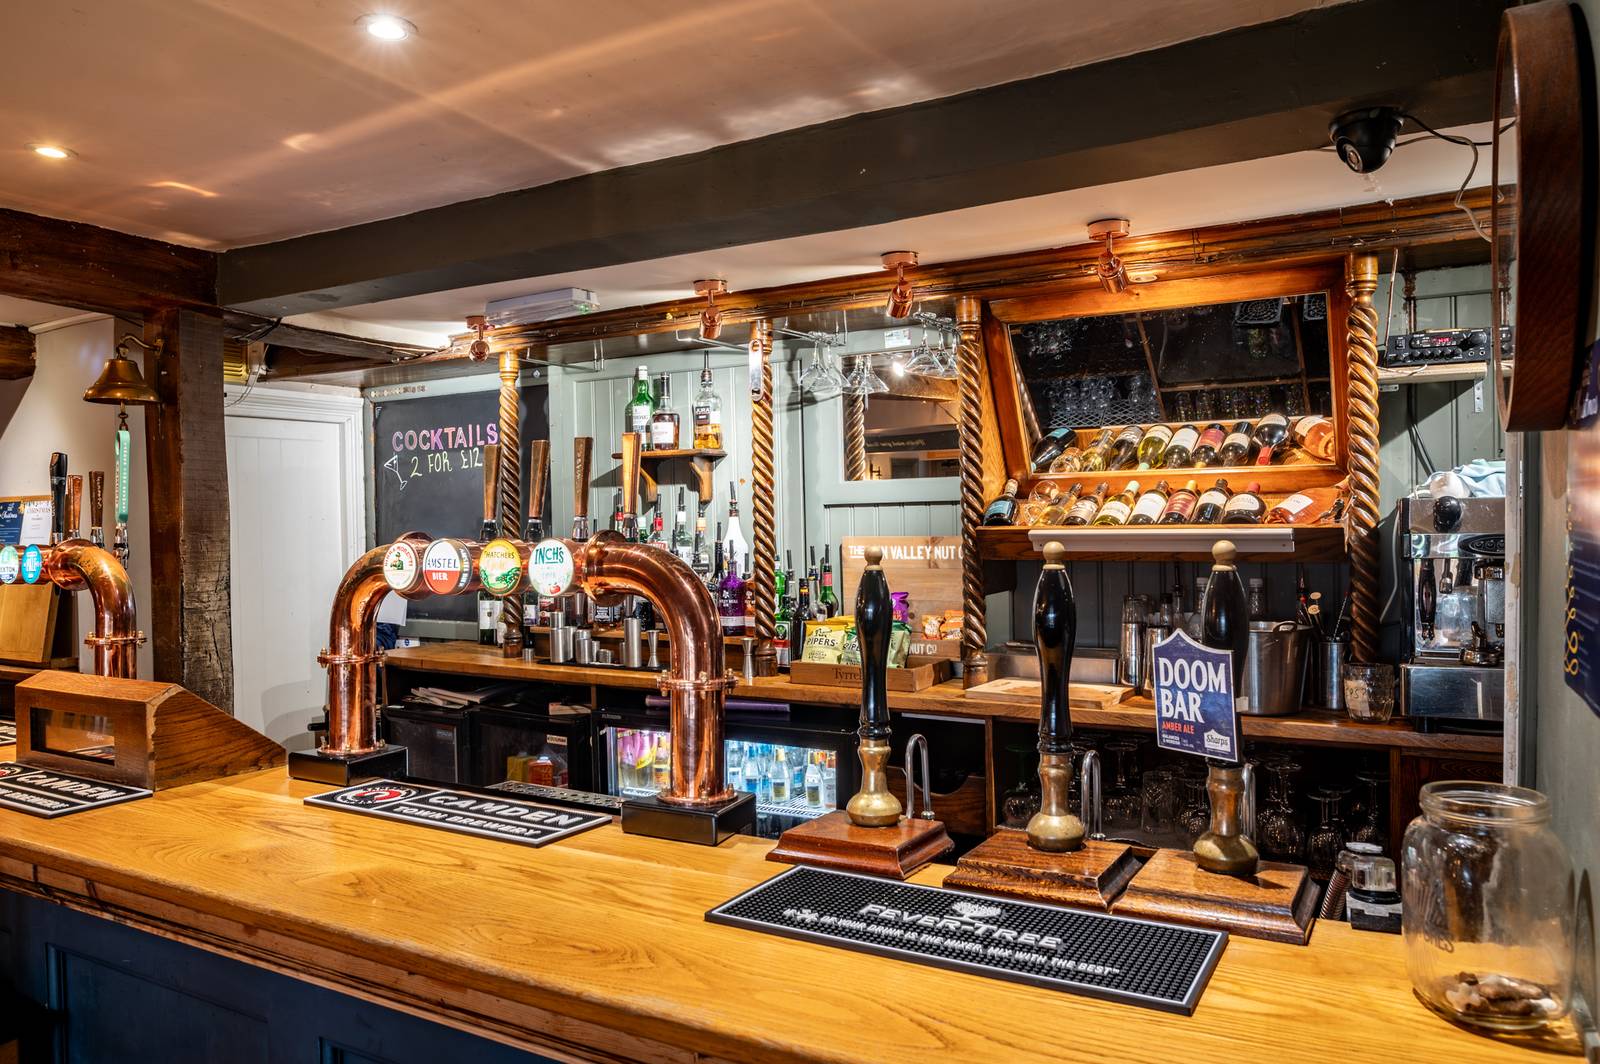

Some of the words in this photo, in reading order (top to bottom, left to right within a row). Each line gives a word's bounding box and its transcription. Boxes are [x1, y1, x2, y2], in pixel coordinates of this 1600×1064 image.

[392, 423, 499, 451] COCKTAILS
[410, 456, 423, 478] 2
[428, 451, 452, 473] FOR
[460, 447, 483, 469] £12
[426, 558, 459, 569] AMSTEL
[484, 551, 516, 560] THATCHERS
[848, 545, 865, 556] THE
[892, 545, 931, 561] VALLEY
[934, 546, 957, 561] NUT
[431, 571, 449, 581] BIER
[807, 637, 836, 647] PIPERS
[909, 643, 926, 655] NUT
[1158, 656, 1228, 695] DOOM
[1160, 688, 1206, 724] BAR
[1162, 720, 1182, 733] AMBER
[1183, 724, 1195, 735] ALE
[17, 774, 126, 800] CAMDEN
[393, 806, 449, 820] TOWN
[445, 816, 542, 837] BREWERY
[428, 795, 584, 826] CAMDEN
[858, 903, 1063, 949] FEVER-TREE
[837, 917, 867, 931] YOUR
[866, 924, 905, 938] DRINK
[904, 931, 919, 941] IS
[919, 933, 944, 946] THE
[986, 946, 1013, 958] MIX
[1014, 950, 1048, 964] WITH
[1050, 957, 1077, 969] THE
